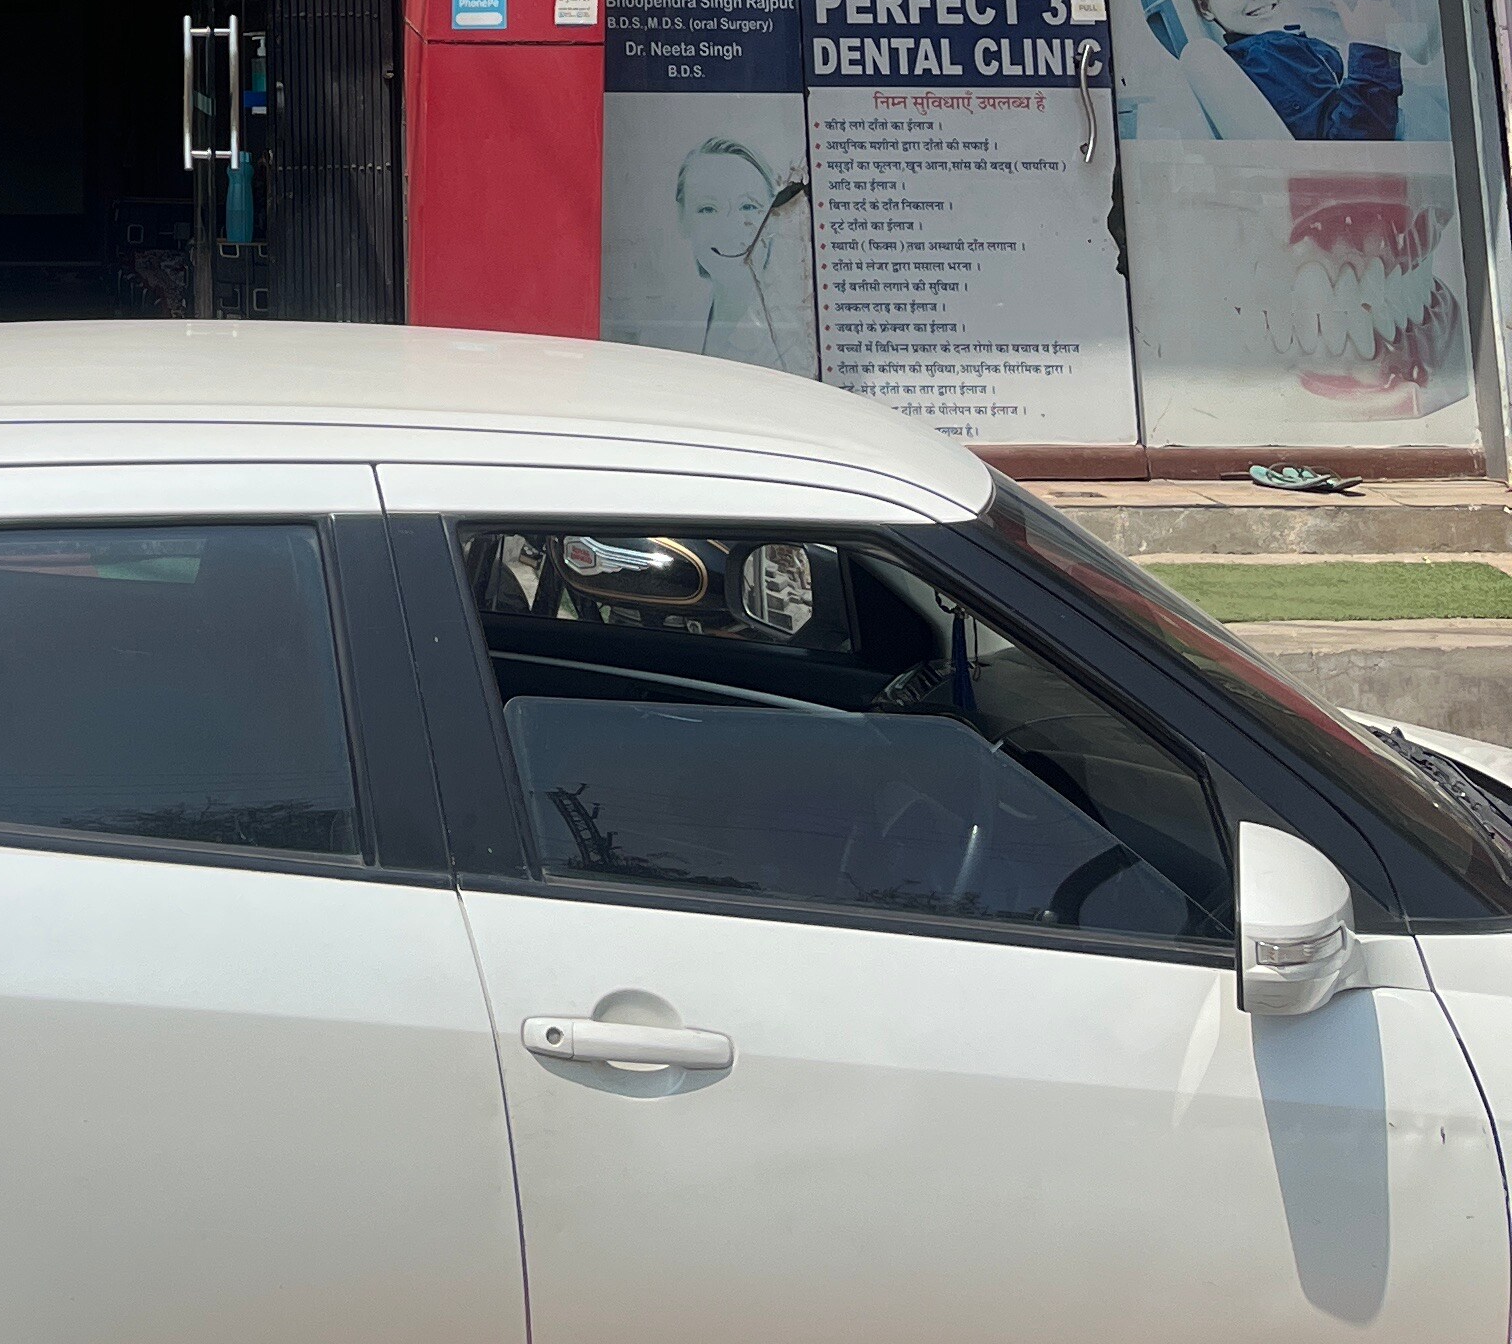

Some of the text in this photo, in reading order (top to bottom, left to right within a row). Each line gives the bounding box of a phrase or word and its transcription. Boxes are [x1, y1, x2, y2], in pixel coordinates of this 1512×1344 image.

[689, 17, 717, 32] (oral
[720, 18, 774, 33] Surgery)
[625, 41, 743, 61] Dr. Neeta Singh
[812, 37, 1104, 77] DENTAL CLINIC
[667, 64, 706, 78] B.D.S.
[873, 91, 908, 110] निम्न
[976, 96, 1031, 111] उपलब्ध
[890, 121, 904, 130] का
[945, 138, 959, 150] की
[857, 161, 872, 171] का
[973, 158, 987, 171] की
[853, 181, 867, 190] का
[871, 221, 884, 231] का
[986, 241, 1017, 251] लगाना
[911, 279, 926, 291] की
[893, 302, 907, 312] का
[913, 323, 927, 332] का
[911, 343, 937, 353] प्रकार
[995, 343, 1009, 353] का
[1011, 343, 1039, 353] बचाव
[861, 361, 875, 373] की
[908, 361, 922, 373] की
[903, 385, 916, 394] का
[973, 406, 987, 415] का
